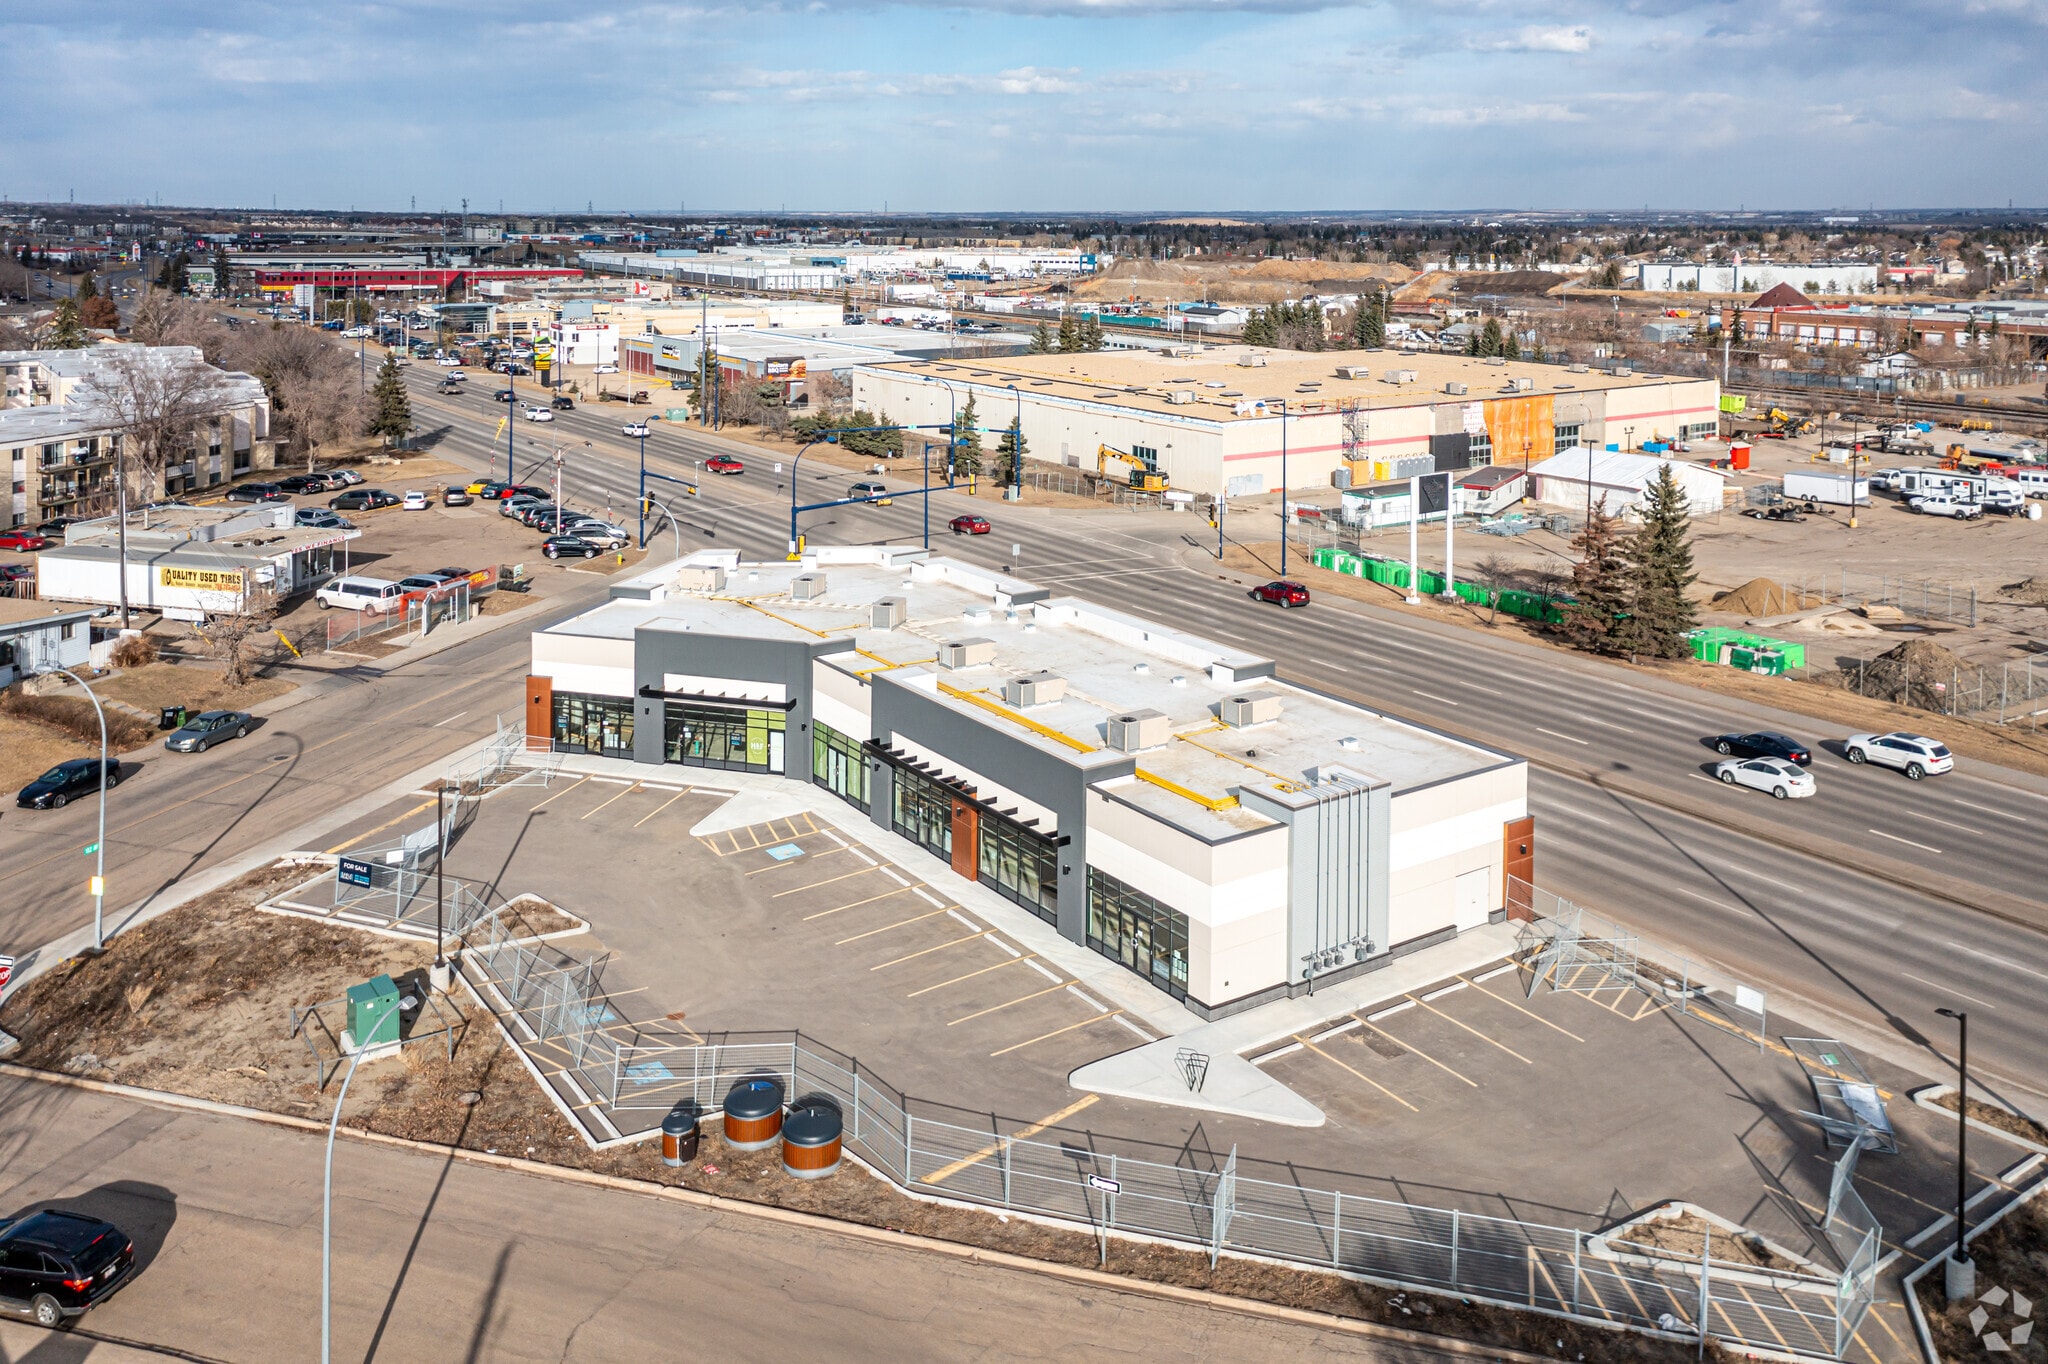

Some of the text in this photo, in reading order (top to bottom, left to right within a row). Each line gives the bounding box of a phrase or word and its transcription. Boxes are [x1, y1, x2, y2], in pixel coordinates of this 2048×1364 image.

[317, 535, 345, 546] FINANCE
[200, 573, 218, 582] USED
[220, 574, 241, 585] TIRES
[355, 865, 367, 873] SALE
